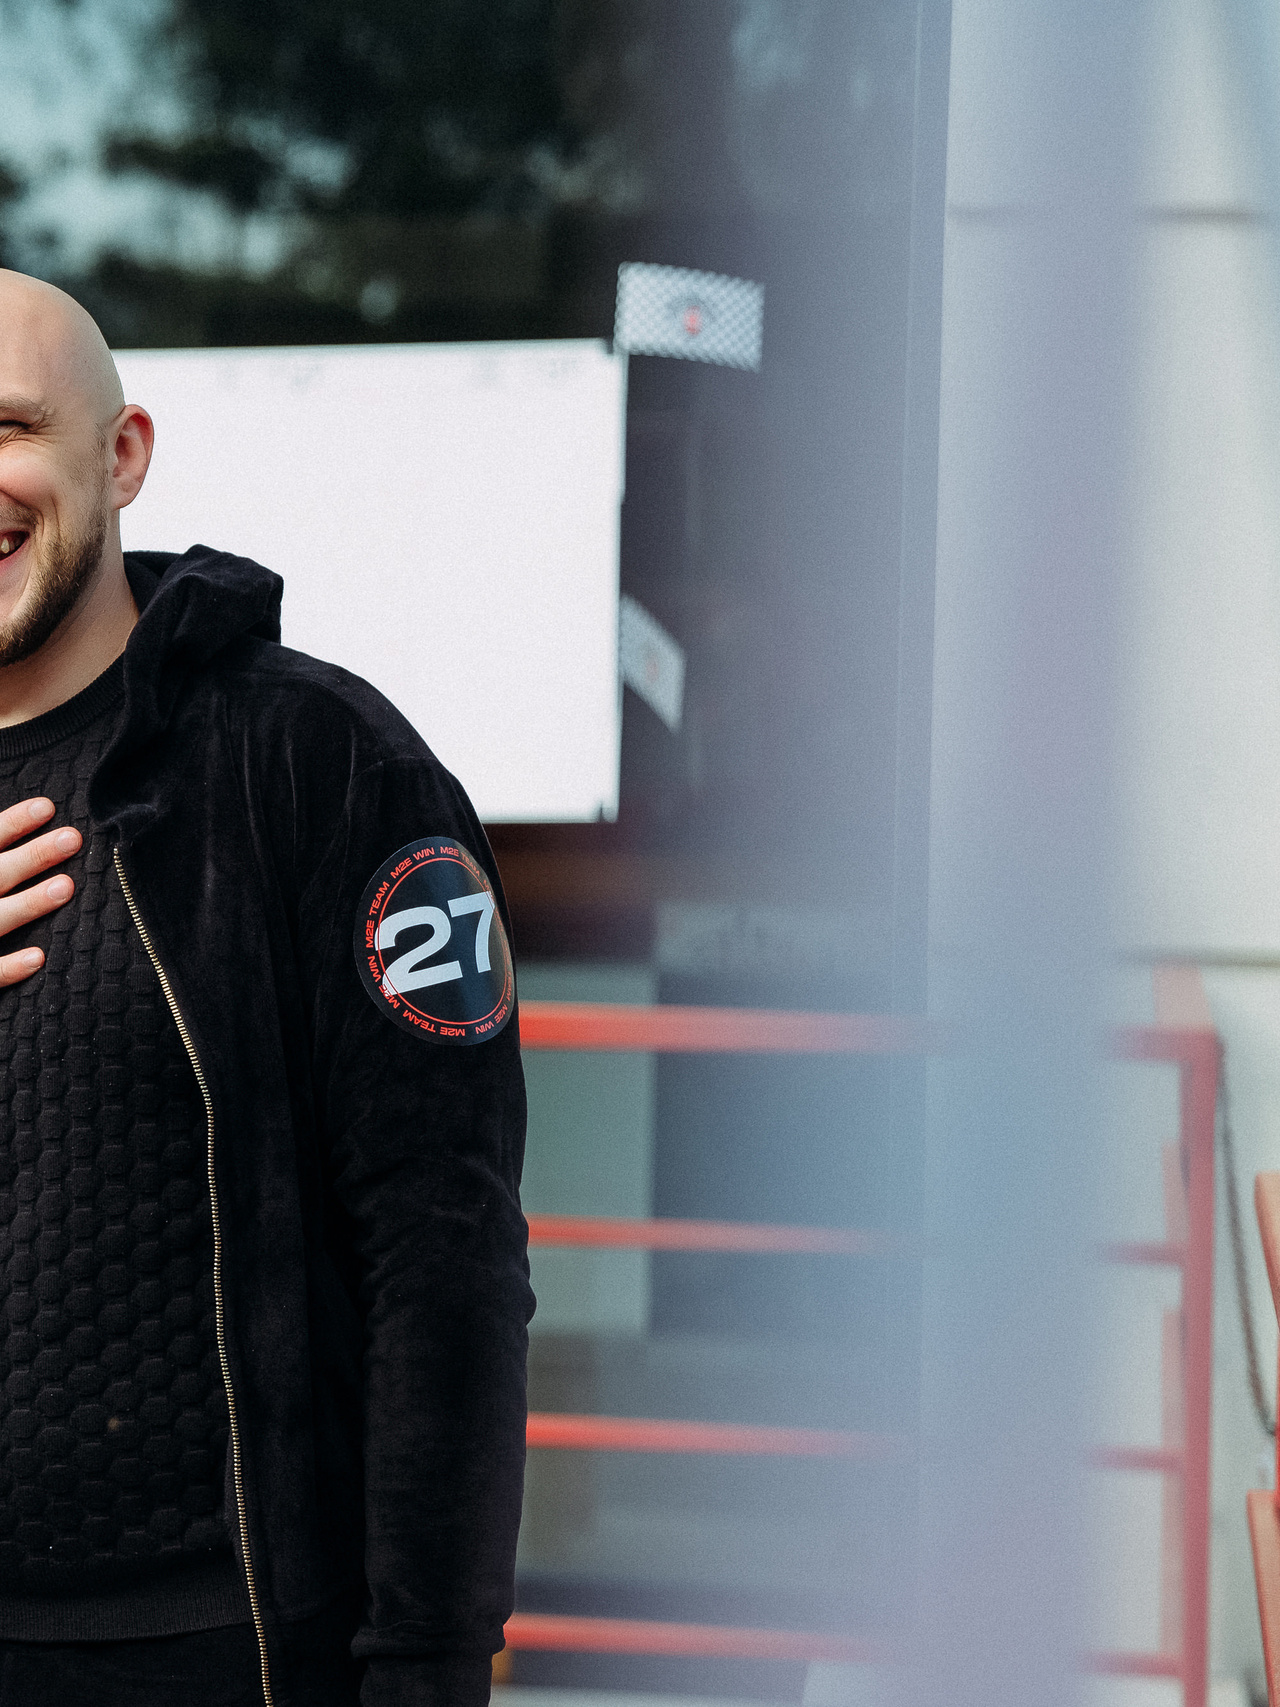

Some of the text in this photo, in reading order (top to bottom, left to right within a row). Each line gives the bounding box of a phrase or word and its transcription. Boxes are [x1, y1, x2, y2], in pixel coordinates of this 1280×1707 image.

[413, 847, 435, 861] WIN
[440, 846, 459, 857] M2E
[390, 857, 413, 879] M2E
[368, 881, 390, 916] TEAM
[365, 920, 375, 948] M2E
[374, 890, 496, 996] 27
[367, 955, 382, 982] WIN
[378, 983, 401, 1009] M2E
[402, 1009, 437, 1033] TEAM
[494, 1003, 509, 1024] M2E
[439, 1026, 466, 1037] M2E
[475, 1020, 495, 1035] WIN
